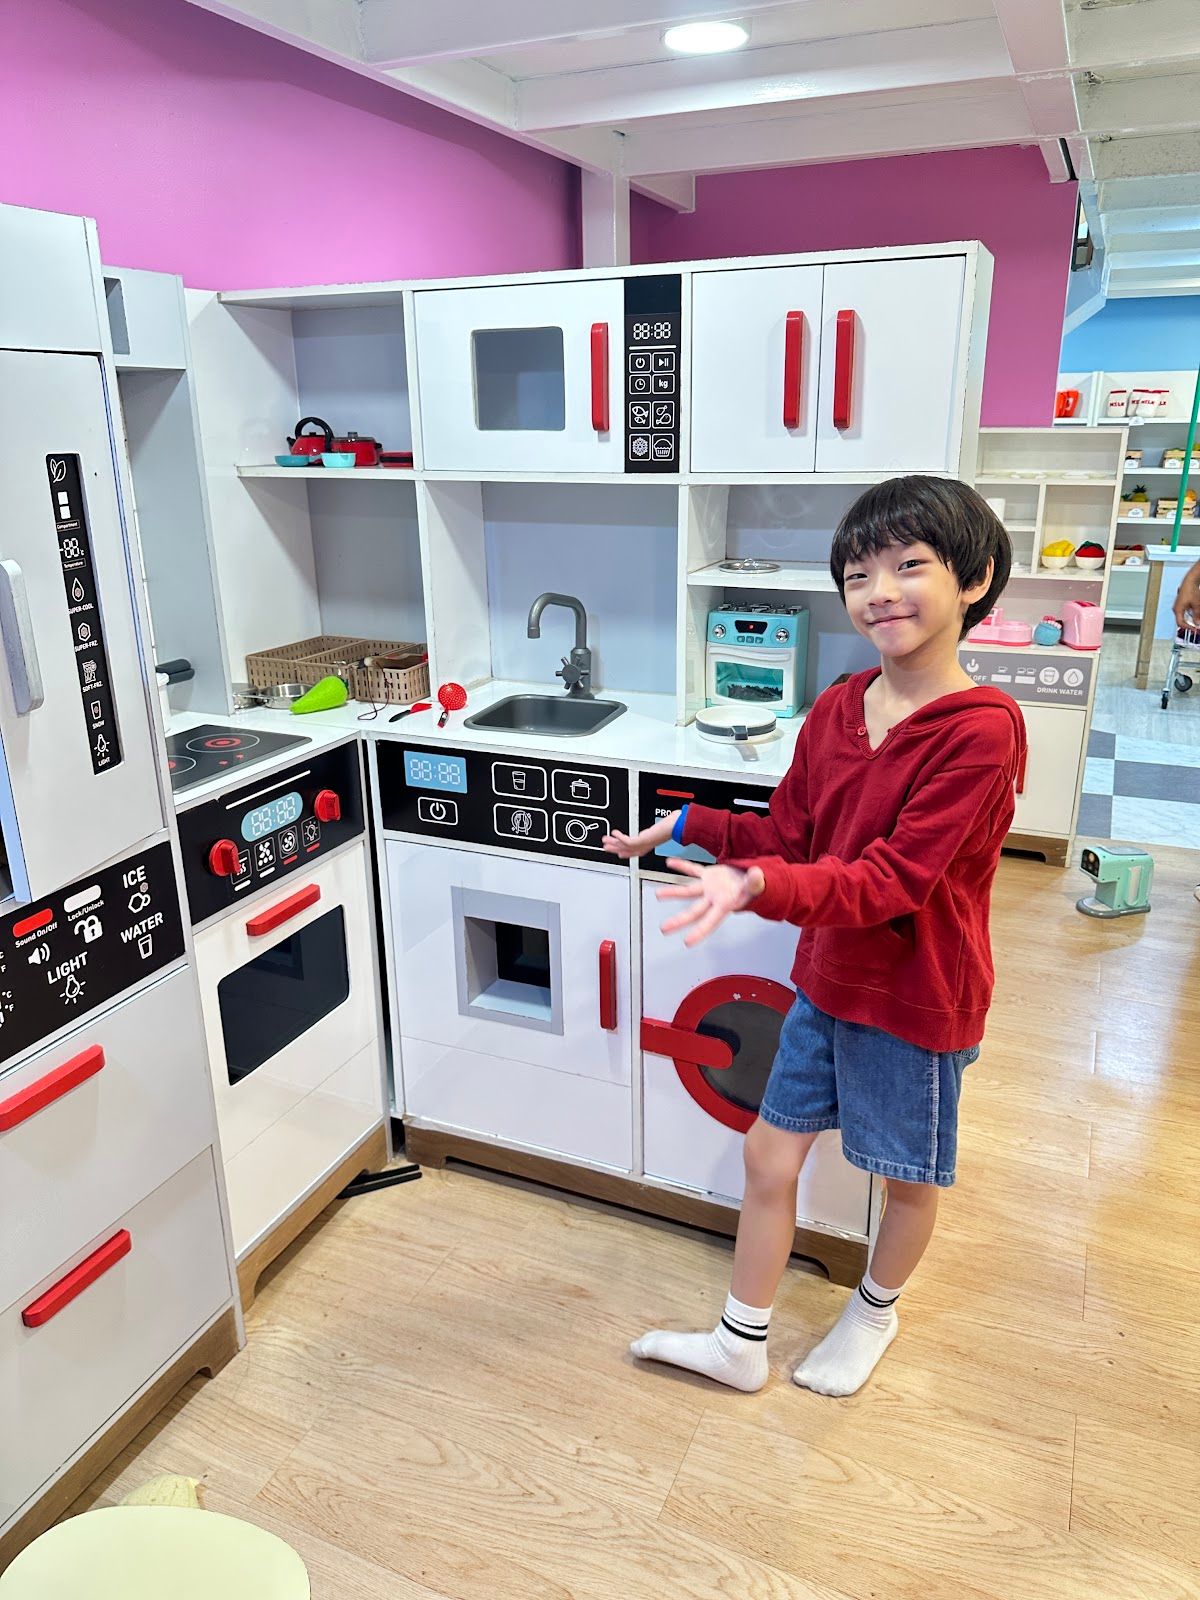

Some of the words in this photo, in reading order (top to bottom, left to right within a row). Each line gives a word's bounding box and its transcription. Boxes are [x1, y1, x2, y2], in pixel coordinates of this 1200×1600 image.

[658, 378, 669, 390] kg
[1036, 686, 1058, 695] DRINK
[1059, 688, 1083, 696] WATER
[92, 719, 105, 730] SNOW
[98, 756, 111, 767] LIGHT
[655, 807, 672, 817] PRO
[122, 865, 147, 889] ICE
[67, 899, 105, 922] Lock/Unlock
[15, 932, 37, 949] Sound
[36, 921, 59, 938] On/Off
[120, 911, 164, 944] WATER
[47, 951, 89, 985] LIGHT
